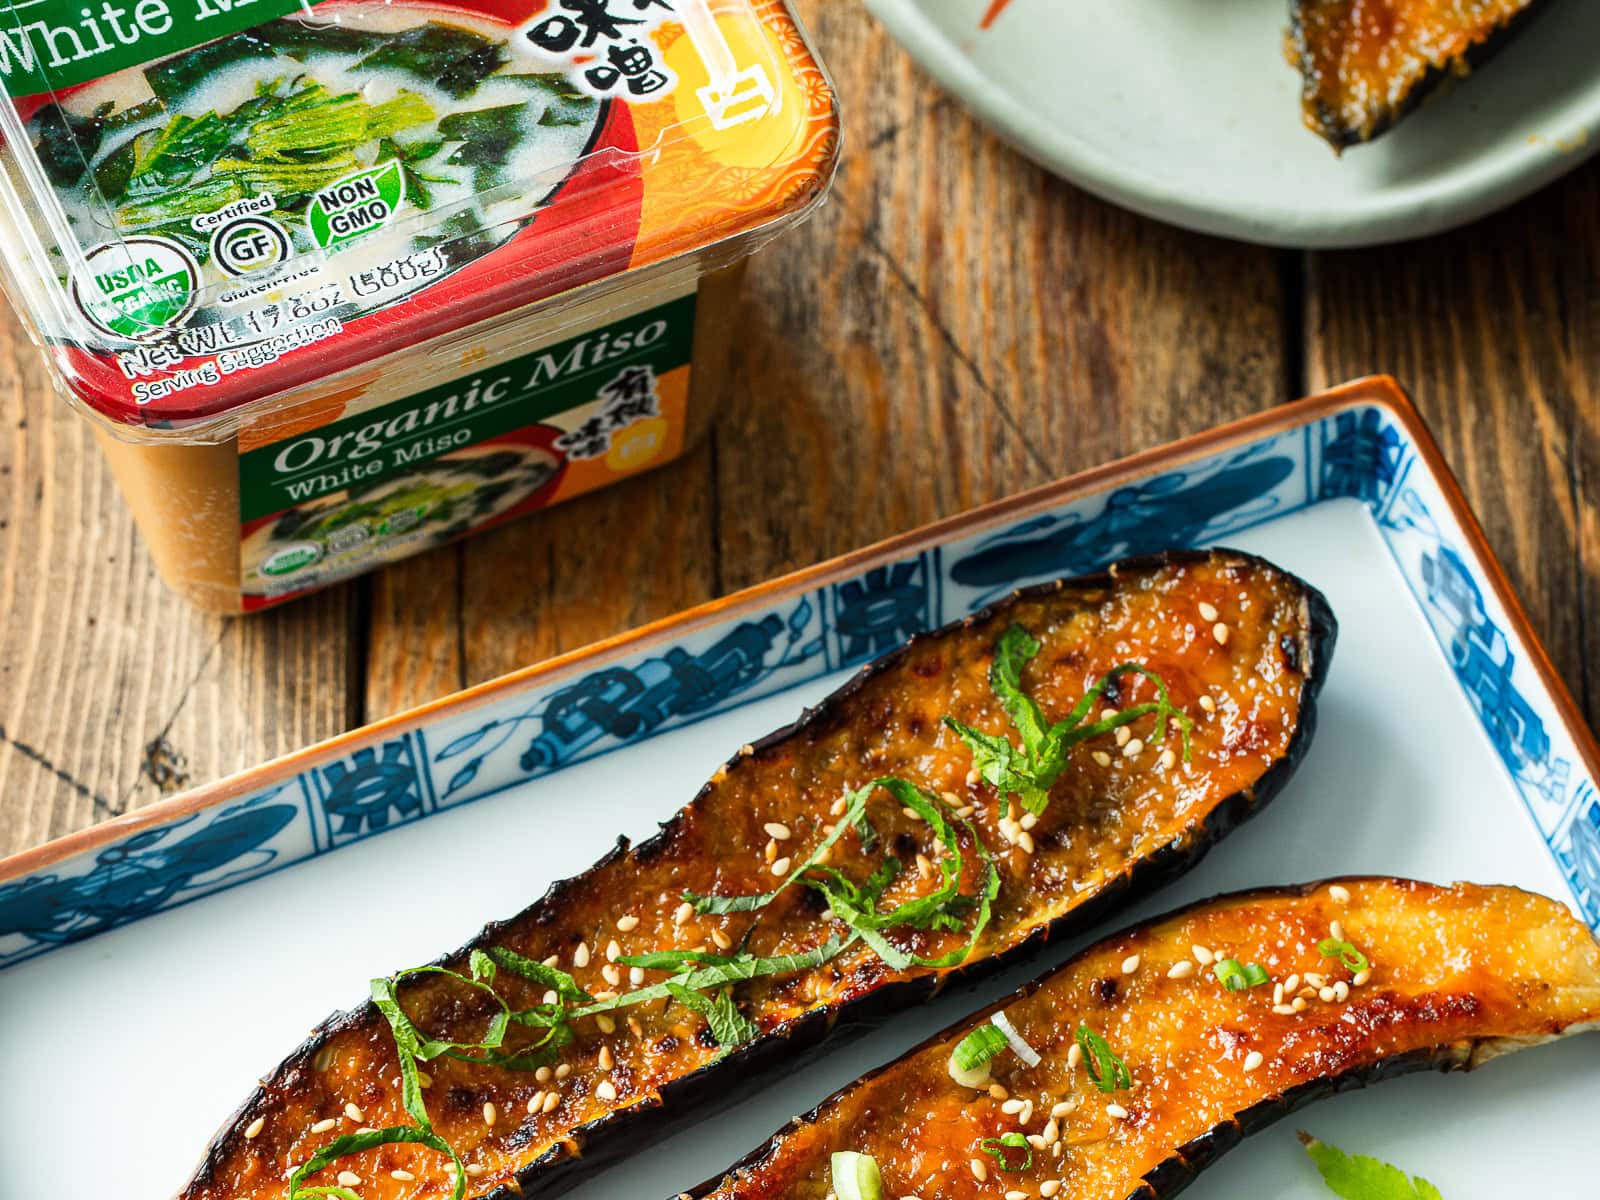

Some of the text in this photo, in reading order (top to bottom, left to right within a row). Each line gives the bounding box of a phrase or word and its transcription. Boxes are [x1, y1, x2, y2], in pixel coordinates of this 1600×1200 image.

[0, 0, 173, 76] White
[195, 196, 271, 229] Certified
[318, 177, 377, 212] NON
[330, 200, 387, 234] GMO
[230, 235, 269, 260] GF
[95, 257, 164, 295] USDA
[122, 344, 181, 378] Net
[350, 246, 444, 296] (500g)
[135, 318, 343, 401] Serving Suggestion
[274, 376, 511, 473] Organic
[523, 320, 667, 390] Miso
[285, 429, 472, 500] White Miso
